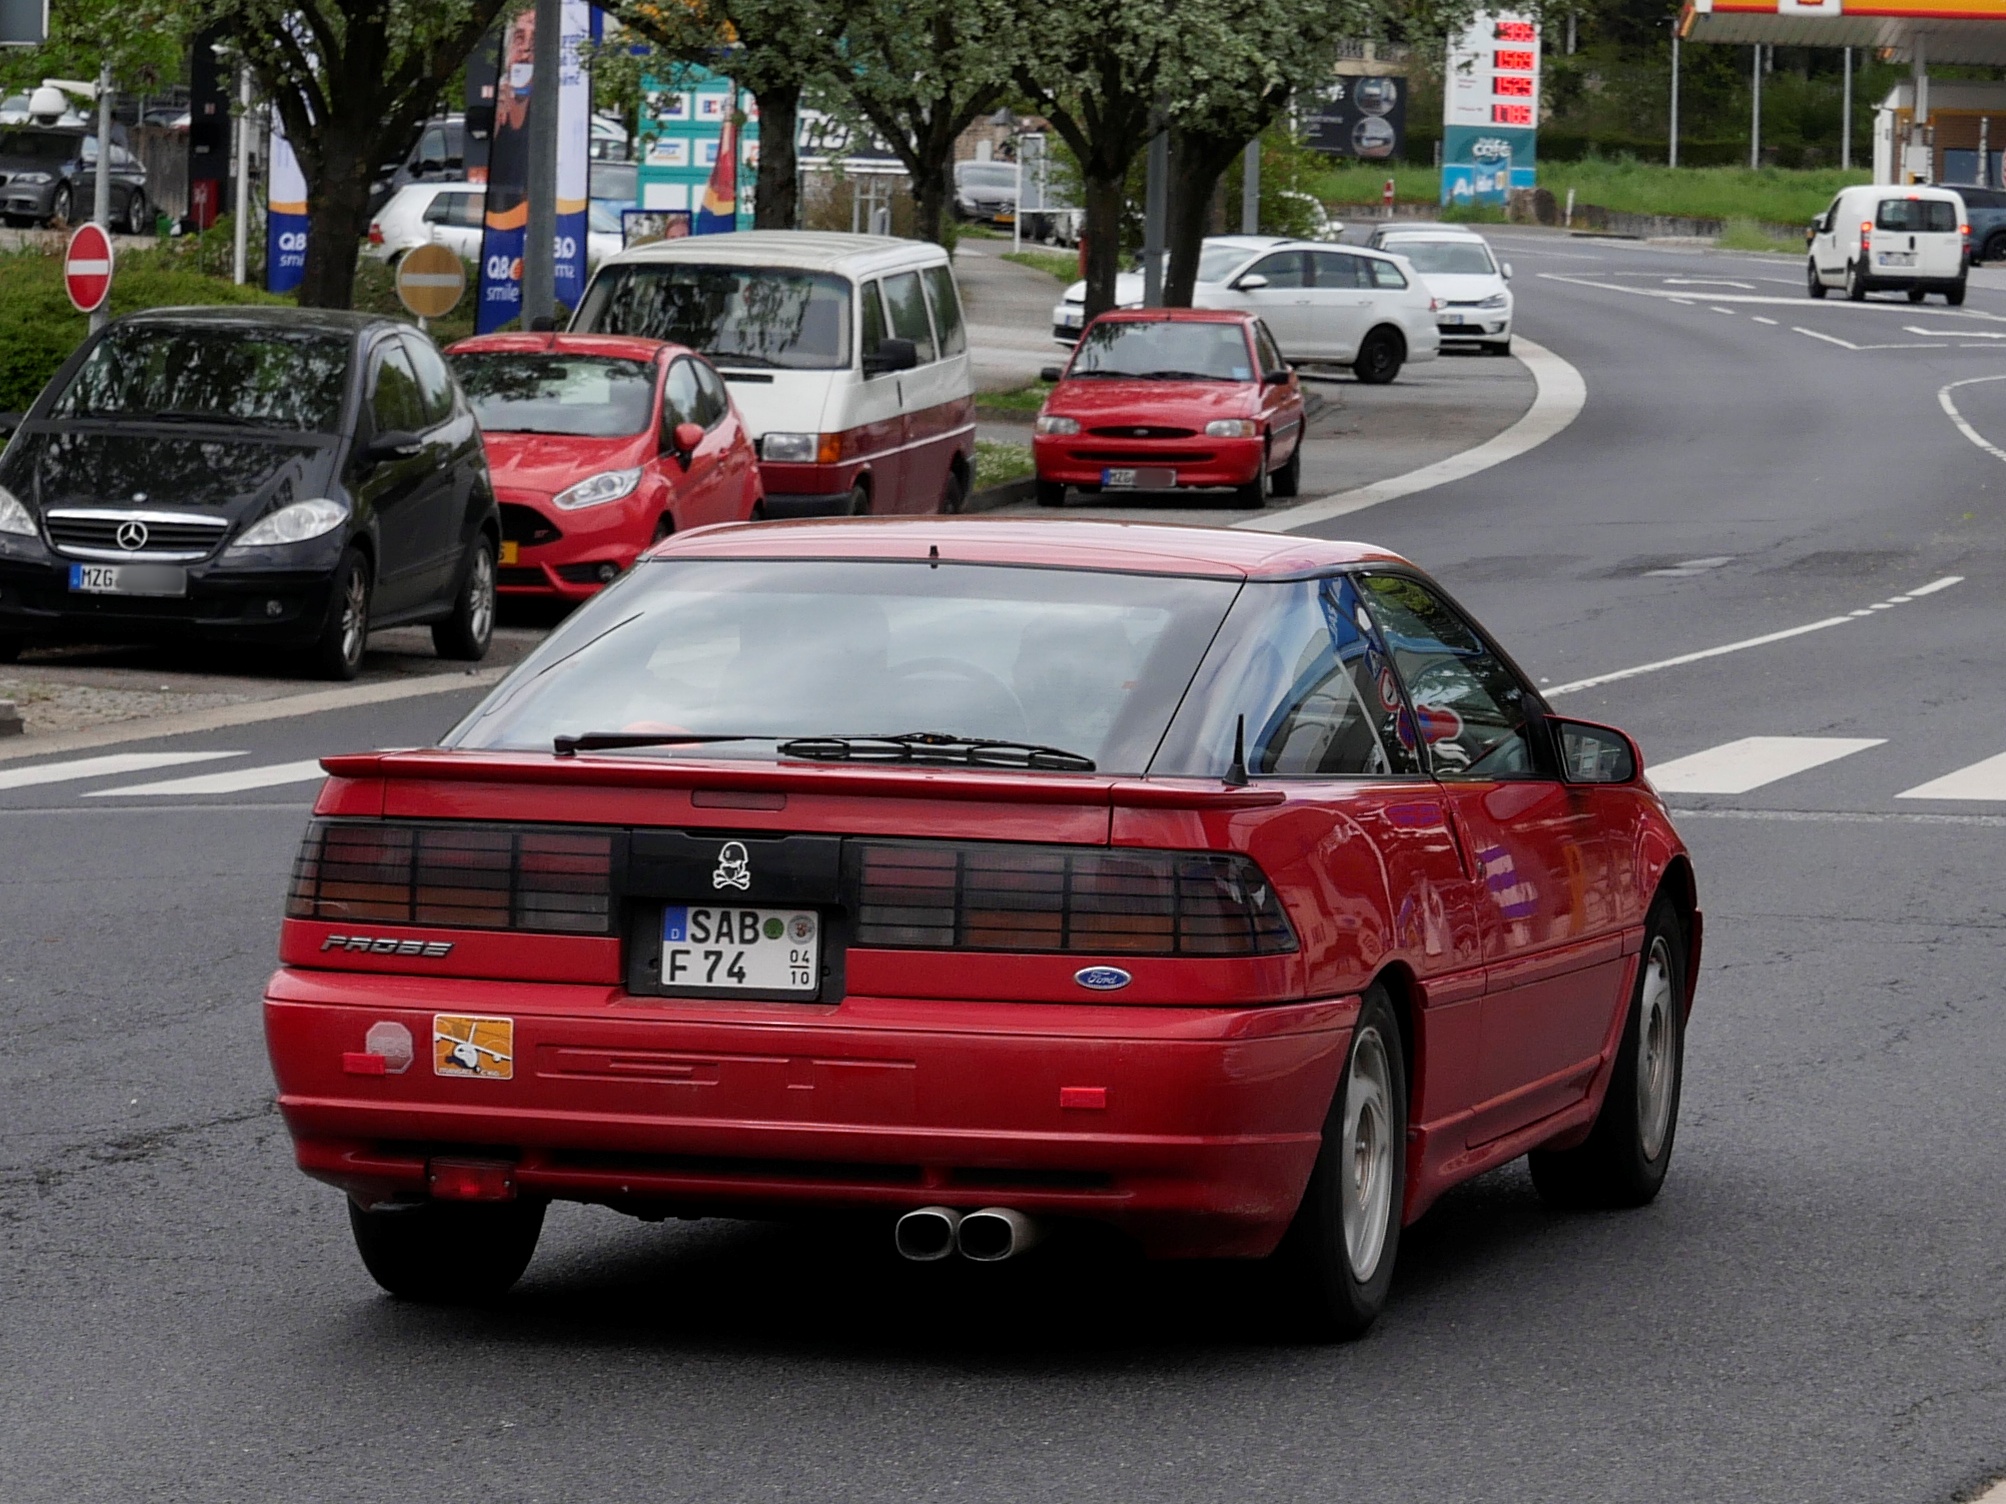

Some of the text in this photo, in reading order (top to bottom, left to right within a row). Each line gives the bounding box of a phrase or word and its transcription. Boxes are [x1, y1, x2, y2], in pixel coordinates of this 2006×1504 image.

[486, 283, 519, 302] smile
[81, 568, 113, 588] MZG
[670, 909, 760, 945] D SAB
[320, 933, 455, 957] PROBE
[669, 949, 746, 984] F 74
[789, 949, 811, 964] 04
[791, 970, 809, 985] 10
